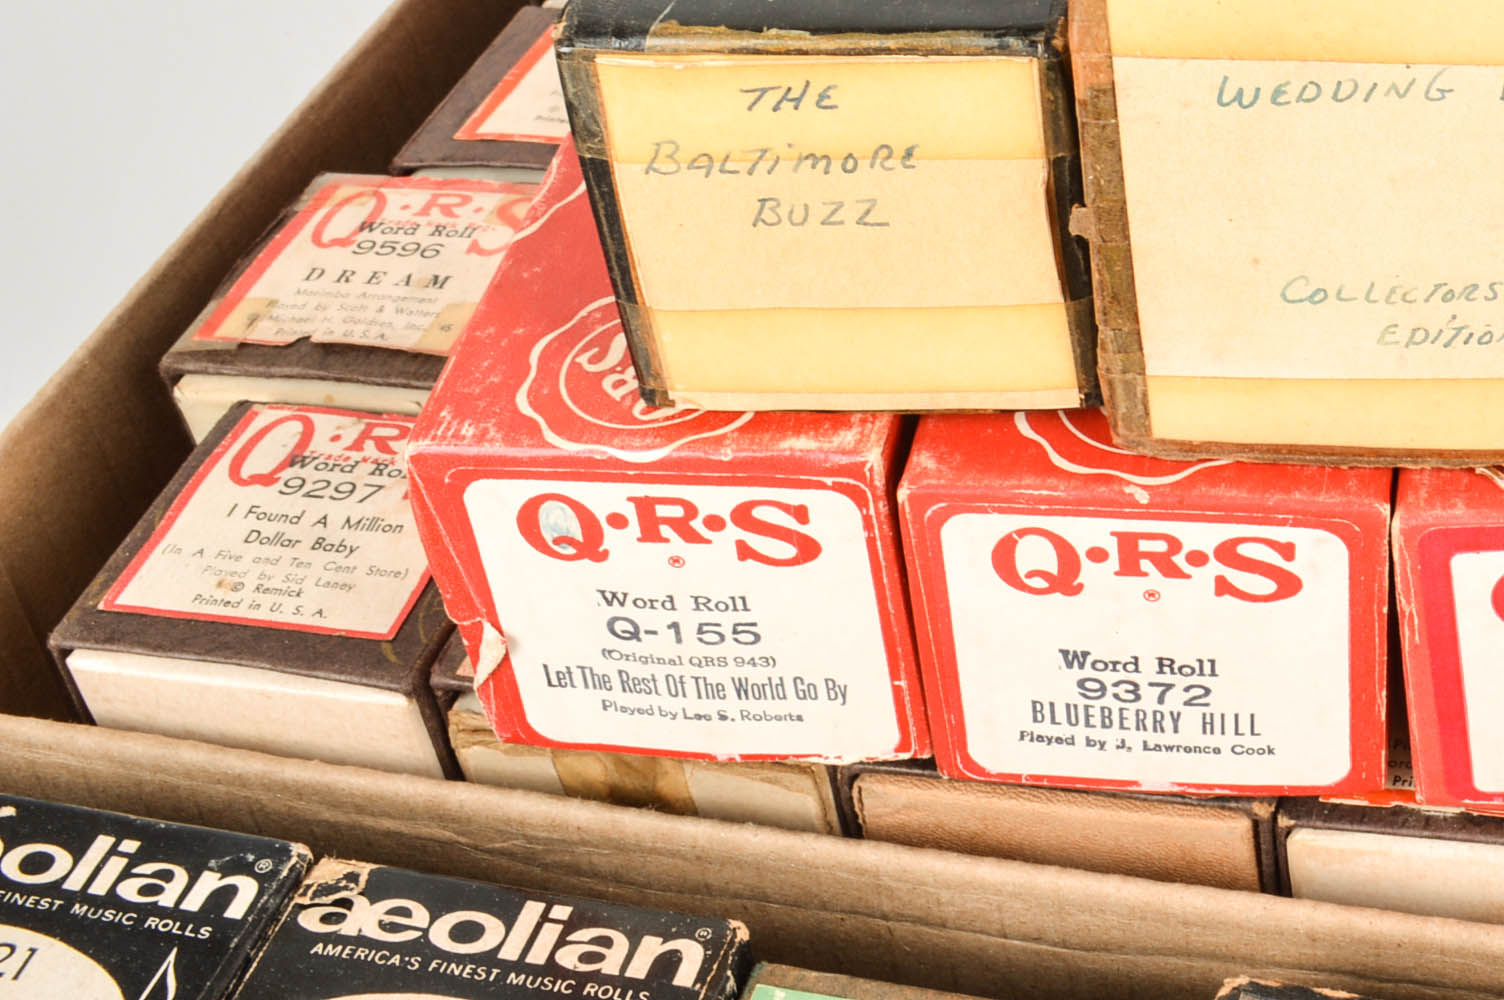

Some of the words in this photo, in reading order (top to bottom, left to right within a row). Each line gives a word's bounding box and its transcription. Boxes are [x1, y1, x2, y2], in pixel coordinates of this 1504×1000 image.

[740, 80, 839, 112] THE
[752, 197, 890, 228] BUZZ
[358, 221, 417, 238] Word
[428, 224, 477, 239] Roll
[352, 240, 445, 259] 9596
[1280, 274, 1503, 305] COLLECTORS
[288, 453, 358, 475] Word
[278, 477, 386, 503] 9297
[226, 504, 239, 518] I
[244, 506, 306, 526] Found
[312, 514, 329, 529] A
[341, 516, 404, 534] Million
[243, 529, 302, 549] Dollar
[311, 536, 360, 559] Baby
[252, 583, 305, 599] Remick
[597, 590, 678, 611] Word
[690, 595, 751, 612] Roll
[606, 616, 762, 646] Q-155
[601, 648, 684, 667] (Original
[688, 656, 729, 668] QRS
[733, 656, 776, 668] 943)
[1058, 649, 1142, 674] Word
[1156, 657, 1220, 678] Roll
[543, 664, 576, 688] Let
[577, 666, 613, 692] The
[617, 669, 662, 696] Rest
[665, 673, 688, 698] Of
[691, 676, 727, 700] The
[731, 676, 787, 701] World
[792, 676, 818, 701] Go
[824, 677, 849, 705] By
[1075, 678, 1212, 707] 9372
[601, 699, 655, 716] Played
[658, 705, 679, 720] by
[717, 710, 735, 722] S.
[740, 710, 805, 722] Roberts
[1031, 700, 1182, 735] BLUEBERRY
[1201, 711, 1262, 737] HILL
[1019, 730, 1076, 747] Played
[1085, 736, 1106, 751] by
[1116, 738, 1132, 752] J.
[1142, 740, 1222, 756] Lawrence
[1231, 744, 1276, 756] Cook
[70, 901, 139, 927] MUSIC
[144, 915, 214, 940] ROLLS
[296, 893, 706, 990] aeolian
[310, 942, 422, 971] AMERICA'S
[428, 959, 503, 984] FINEST
[507, 970, 579, 995] MUSIC
[583, 982, 652, 1000] ROLLS
